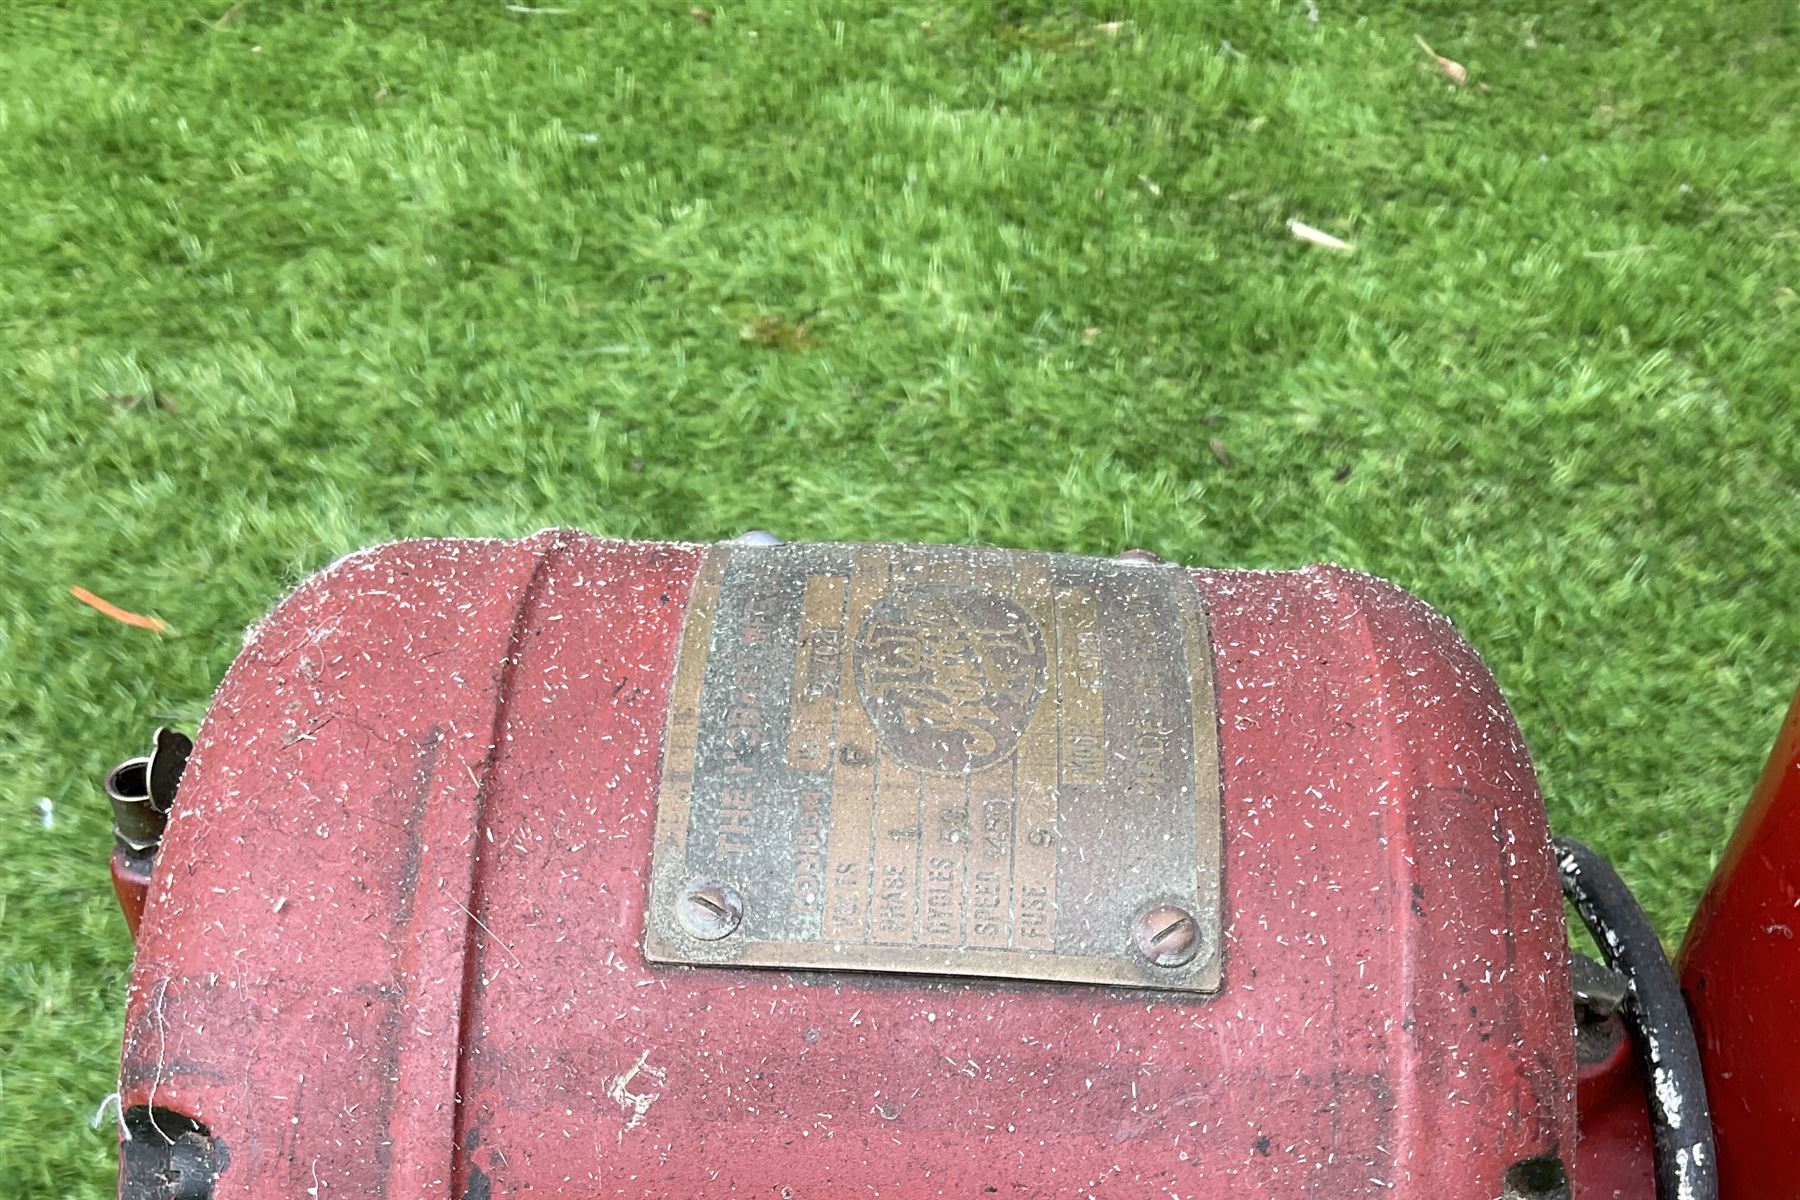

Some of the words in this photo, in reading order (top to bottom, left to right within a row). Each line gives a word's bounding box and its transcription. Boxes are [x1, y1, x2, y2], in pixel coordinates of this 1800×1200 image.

[1135, 719, 1166, 796] MADE
[717, 788, 752, 861] THE
[879, 863, 908, 932] PHASE
[926, 856, 956, 935] CYCLES
[974, 869, 1001, 938] SPEED
[1021, 884, 1048, 939] FUSE
